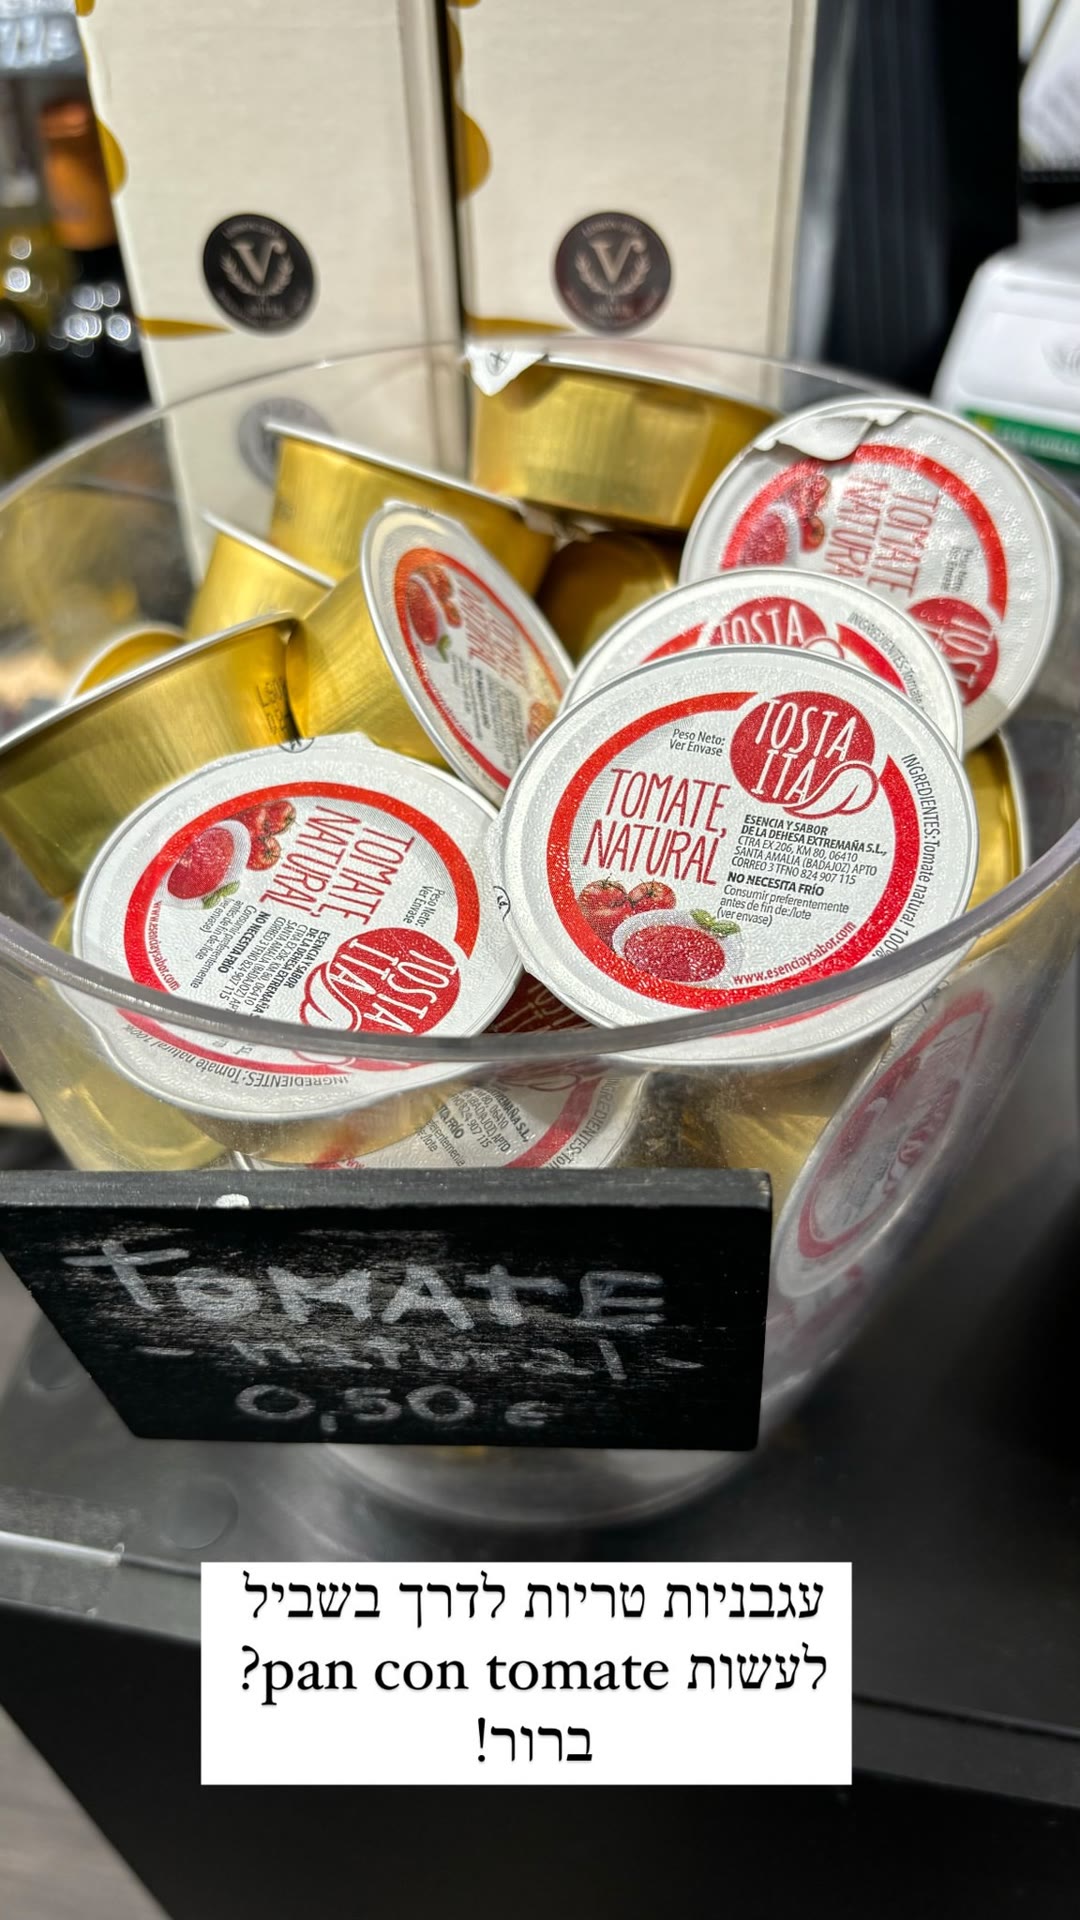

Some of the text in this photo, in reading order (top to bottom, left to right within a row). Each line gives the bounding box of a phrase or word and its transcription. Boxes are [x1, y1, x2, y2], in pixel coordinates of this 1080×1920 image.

[822, 476, 889, 578] NATURA
[672, 728, 726, 747] Peso Neto:
[754, 698, 857, 763] TOSTA
[669, 738, 723, 757] Ver Envase
[750, 749, 817, 804] ITA
[606, 767, 732, 838] TOMATE,
[741, 824, 754, 835] DE
[754, 827, 767, 838] LA
[768, 829, 805, 845] DEHESA
[806, 834, 865, 853] EXTREMAÑA
[743, 814, 829, 836] ESENCIA Y SABOR
[259, 805, 362, 912] NATURAL
[581, 819, 720, 887] NATURAL
[733, 845, 878, 876] SANTA AMALIA (BADAJOZ) APTO
[737, 835, 859, 862] CTRA EX 206, KM 80, 06410
[922, 840, 941, 883] Tomate
[727, 871, 825, 897] NO NECESITA FRÍO
[731, 855, 857, 885] CORREO 3 TFNO 824 907 115
[226, 899, 244, 919] antes
[403, 884, 435, 925] Ver Envase
[419, 887, 446, 929] Peso Neto:
[719, 896, 746, 909] antes
[745, 899, 760, 911] de
[760, 901, 774, 914] fin
[723, 884, 850, 914] Consumir preferentemente
[899, 880, 929, 929] natural
[219, 916, 233, 927] de
[716, 906, 774, 928] (ver envase)
[217, 910, 272, 974] NO NECESITA FRÍO
[299, 937, 313, 948] LA
[304, 930, 331, 962] ESENCIA
[305, 927, 319, 939] DE
[189, 933, 234, 989] preferentemente
[238, 959, 254, 973] 824
[280, 947, 307, 971] DEHESA
[328, 938, 400, 996] ITA
[732, 920, 857, 986] www.esenciaysabor.com
[229, 971, 245, 986] 907
[283, 964, 308, 989] SABOR
[219, 985, 235, 1001] 115
[244, 981, 266, 1006] 06410
[252, 969, 289, 1014] EXTREMAÑA
[363, 949, 459, 1034] TOSTA
[150, 1041, 194, 1063] natural
[197, 1057, 242, 1084] Tomate
[490, 1133, 511, 1152] APTO
[236, 1384, 475, 1433] 0,50
